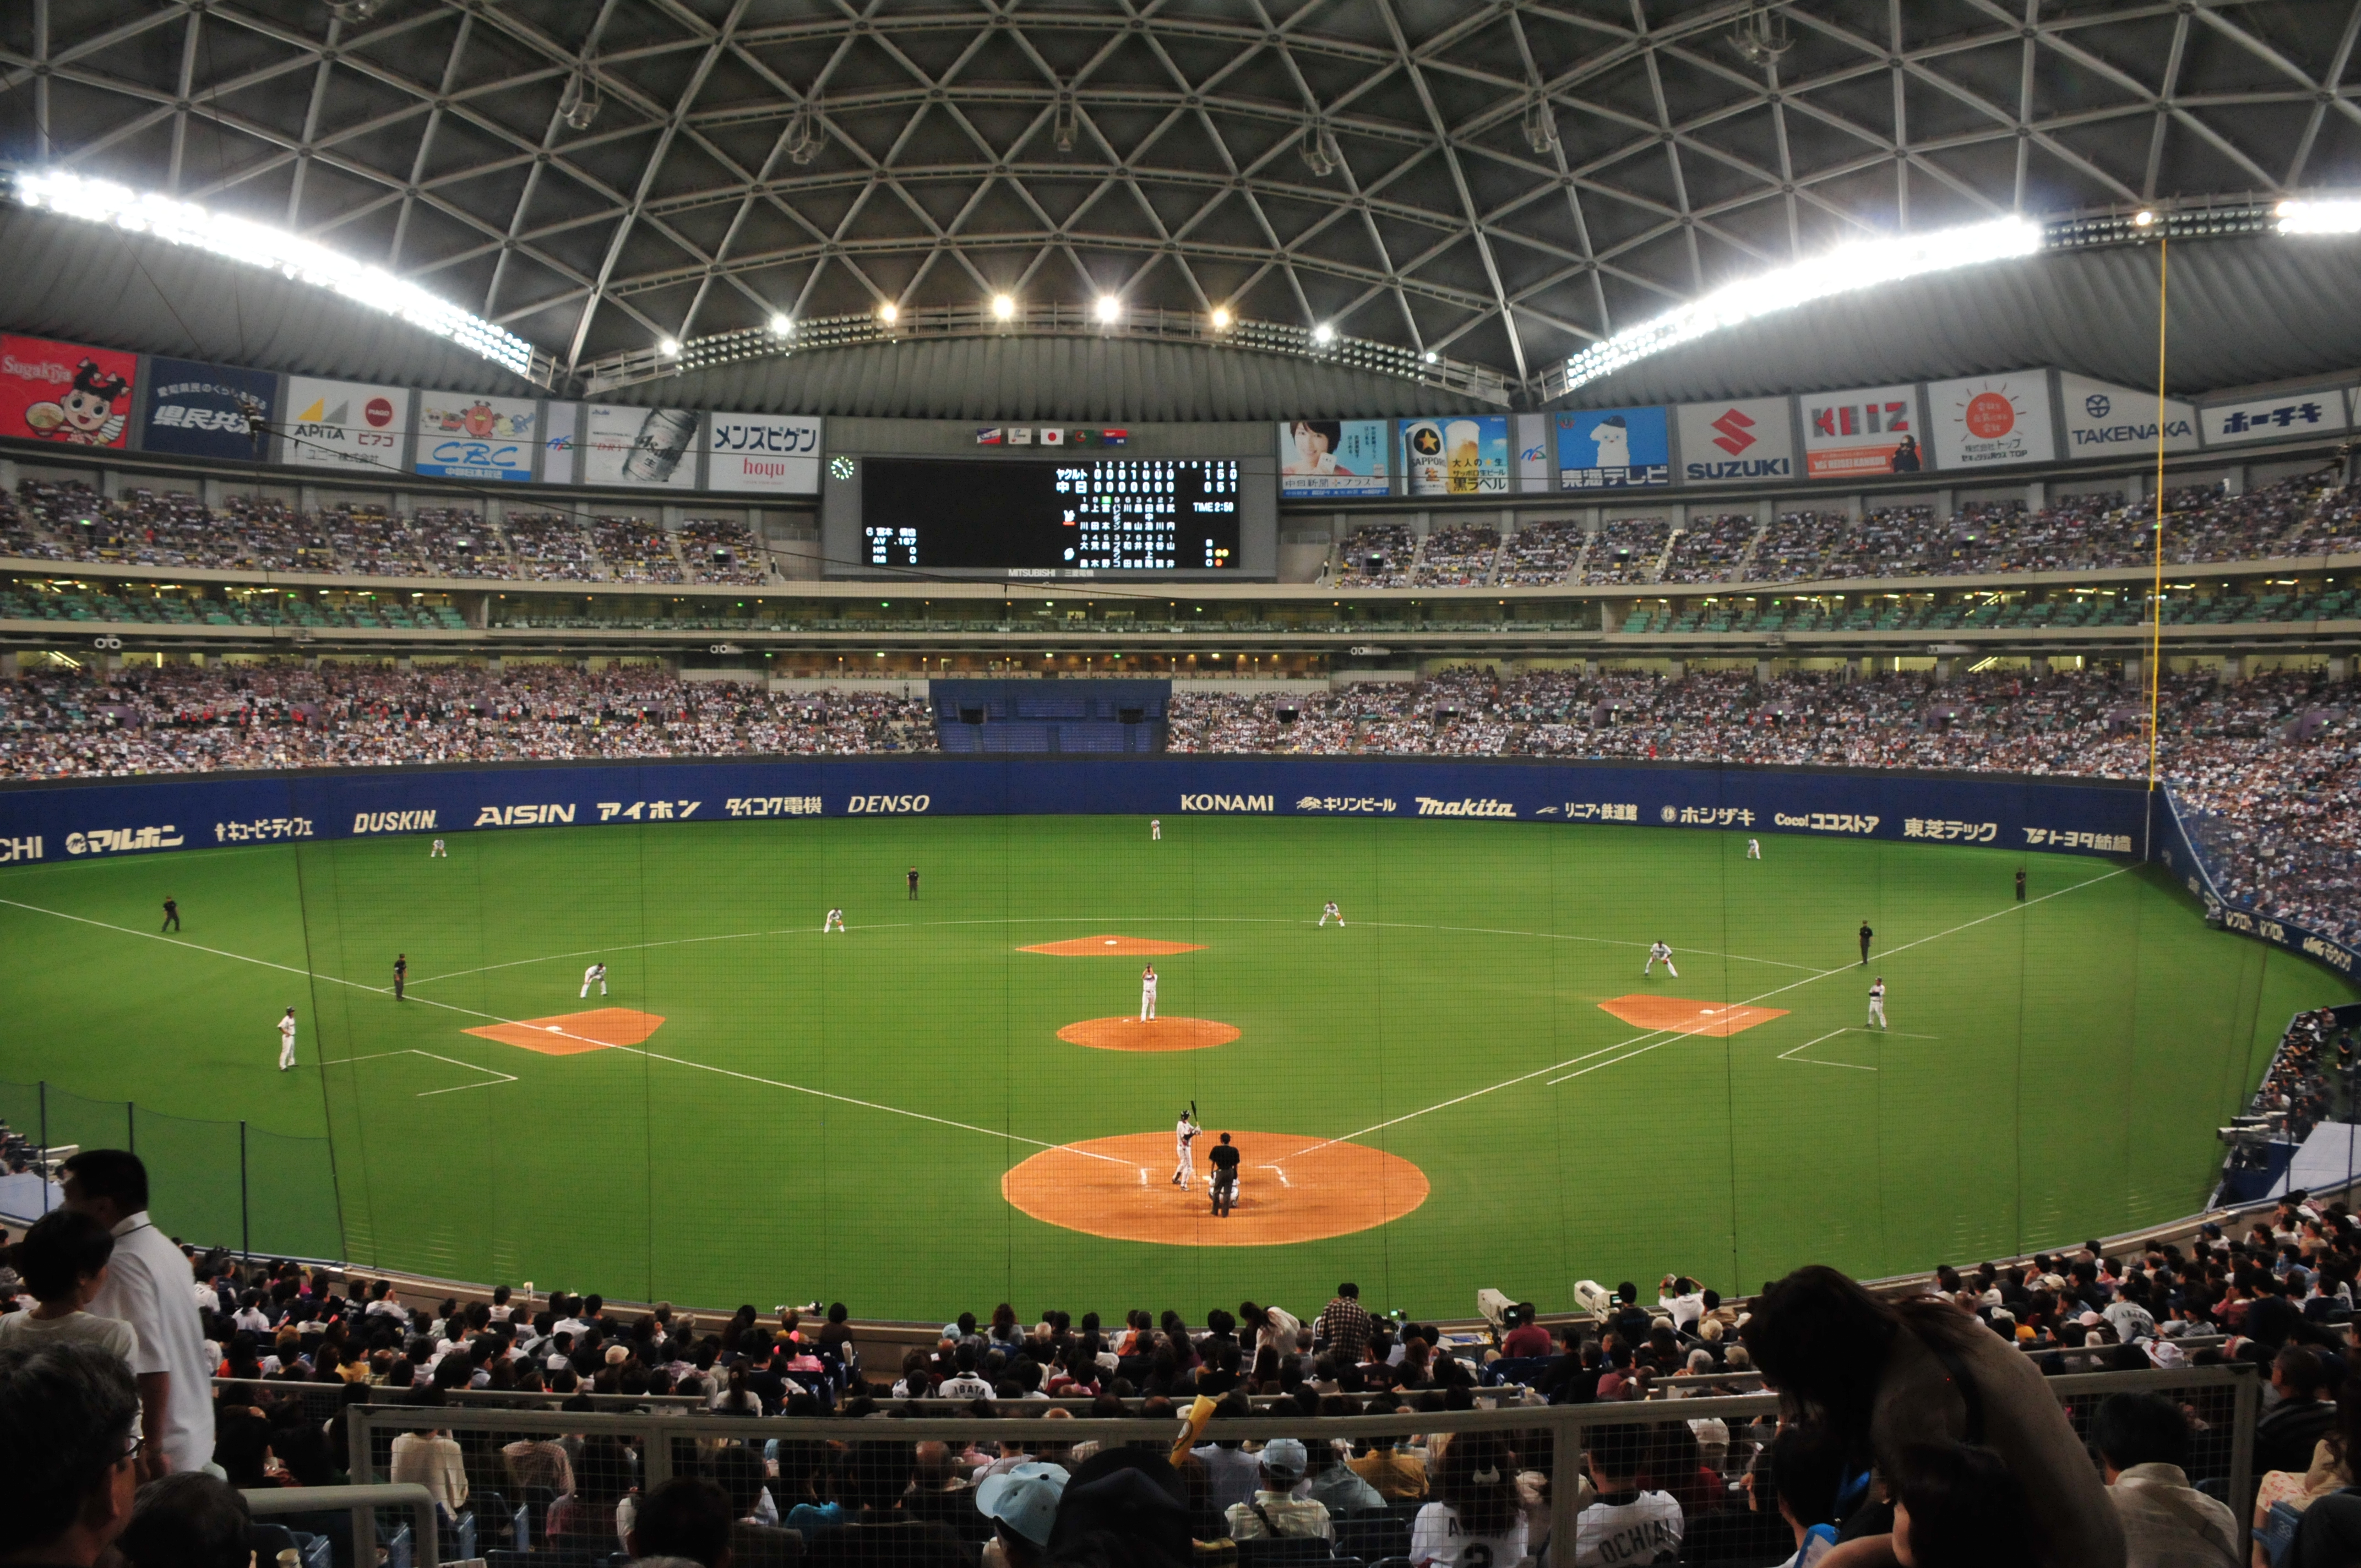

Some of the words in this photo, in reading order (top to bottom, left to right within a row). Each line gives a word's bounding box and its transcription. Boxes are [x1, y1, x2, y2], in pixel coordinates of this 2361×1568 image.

[2223, 402, 2322, 434] ホーチキ
[358, 432, 394, 447] ピアゴ
[2072, 421, 2191, 444] TAKENAKA
[433, 441, 518, 466] CBC
[743, 457, 785, 478] hoyu
[1056, 469, 1087, 480] ヤクルト
[1094, 469, 1101, 480] 0
[1106, 469, 1113, 480] 0
[1118, 469, 1125, 480] 0
[1131, 469, 1136, 480] 1
[1205, 469, 1210, 480] 1
[1425, 467, 1440, 482] 生
[1562, 466, 1668, 488] 東海テレビ
[1687, 458, 1789, 480] SUZUKI
[1094, 482, 1101, 493] 0
[1106, 482, 1113, 493] 0
[1118, 482, 1125, 493] 0
[1130, 482, 1138, 493] 0
[1143, 482, 1150, 493] 0
[1155, 482, 1162, 493] 0
[1167, 482, 1174, 493] 0
[1204, 482, 1211, 493] 0
[1230, 482, 1236, 493] 1
[1285, 478, 1329, 488] 中日新聞
[1454, 477, 1506, 491] 黒ラベル
[1193, 502, 1213, 512] TIME
[1215, 502, 1233, 512] 2:50
[1008, 569, 1056, 577] MITSUBISHI
[597, 800, 702, 821] アイホン
[725, 797, 823, 816] ダイコク電機
[847, 795, 931, 813] DENSO
[1180, 794, 1274, 812] KONAMI
[1323, 797, 1396, 812] キリンビール
[1565, 802, 1638, 821] リニア・鉄道館
[474, 803, 576, 826] AISIN
[1680, 807, 1755, 826] ホシザキ
[1810, 813, 1879, 833] ココストア
[87, 825, 184, 852] マルホン
[1903, 818, 1998, 842] 東芝テック
[2049, 829, 2132, 853] トヨタ紡織
[954, 1385, 986, 1397] IBATA
[1598, 1518, 1672, 1563] OCHIAI
